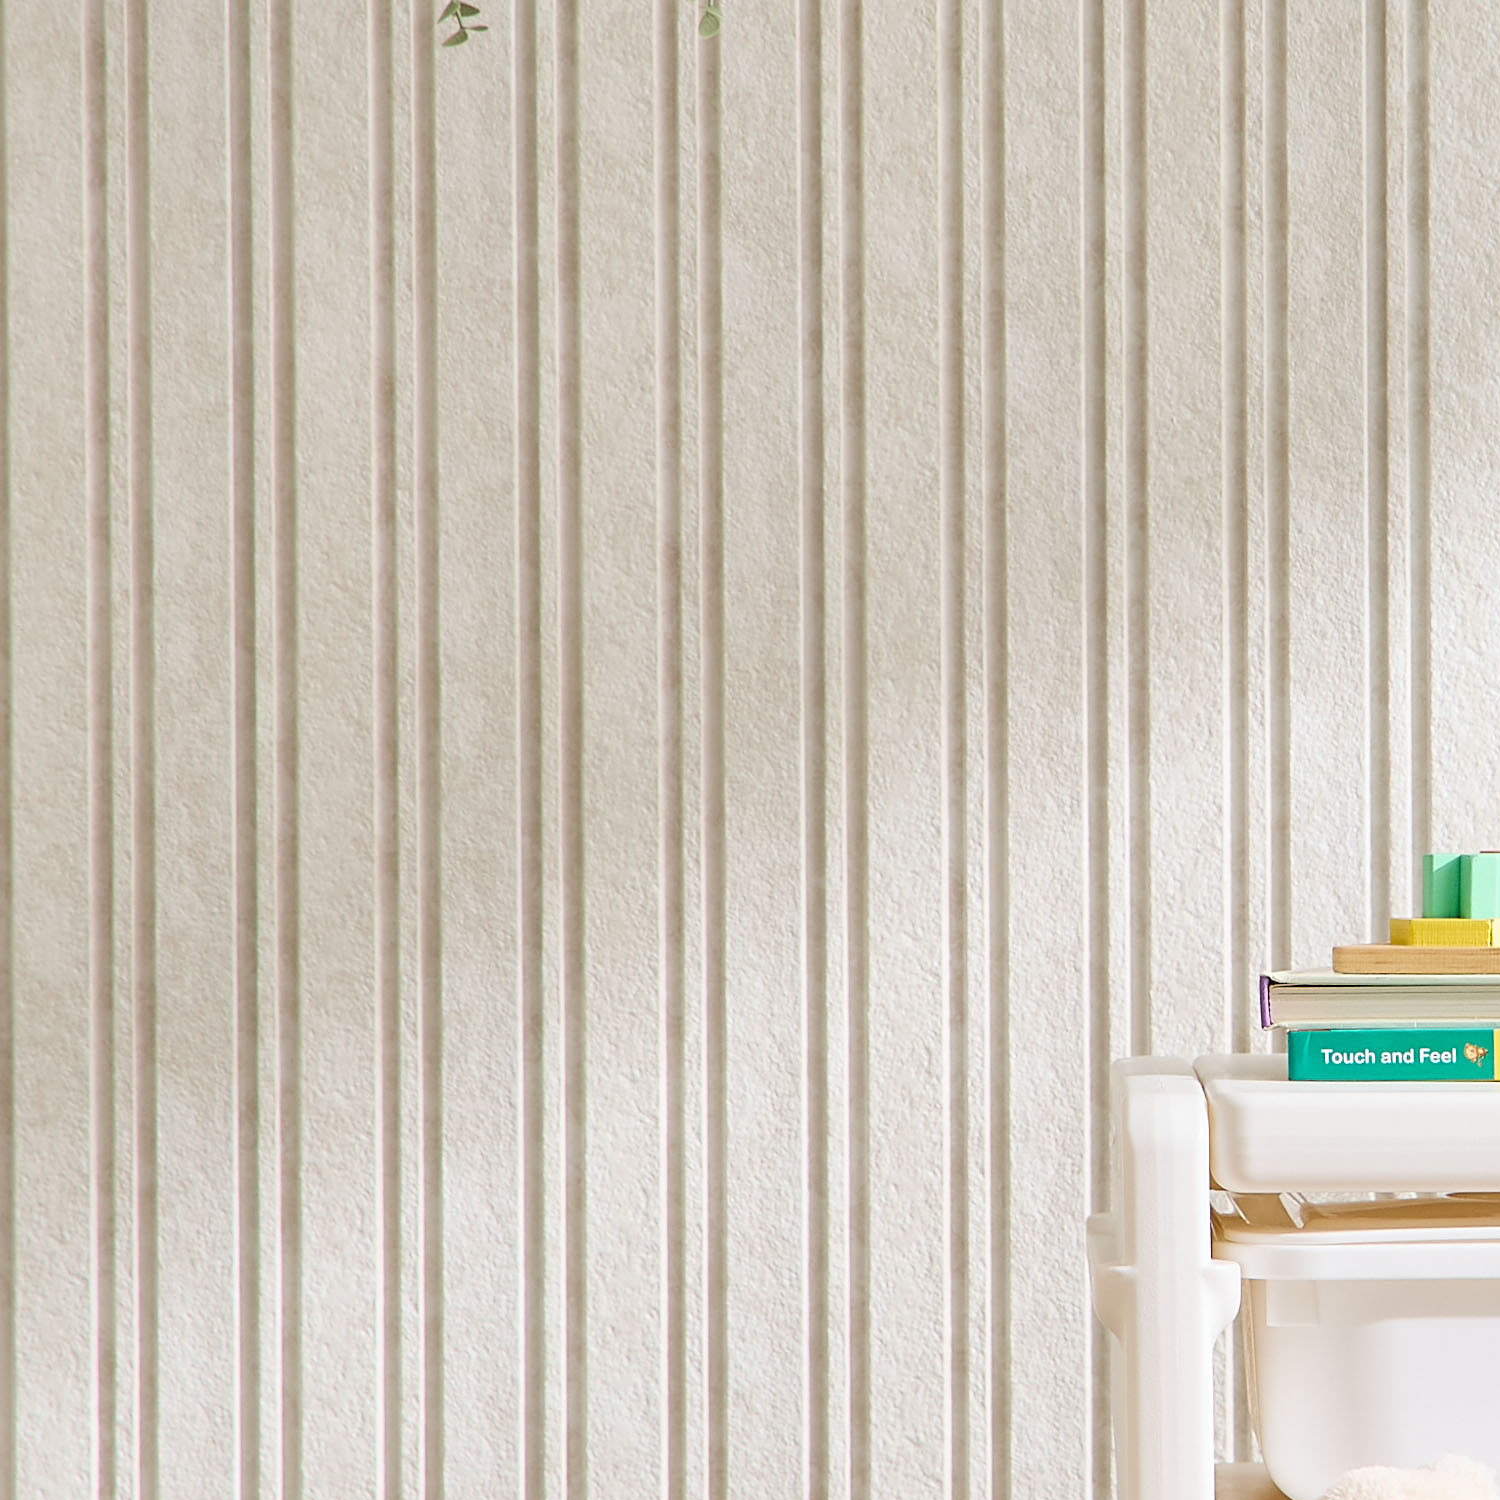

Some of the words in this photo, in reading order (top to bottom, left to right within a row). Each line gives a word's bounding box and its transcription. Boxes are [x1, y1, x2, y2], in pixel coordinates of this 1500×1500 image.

[1320, 1048, 1376, 1064] Touch
[1380, 1048, 1415, 1064] and
[1419, 1048, 1457, 1064] Feel
